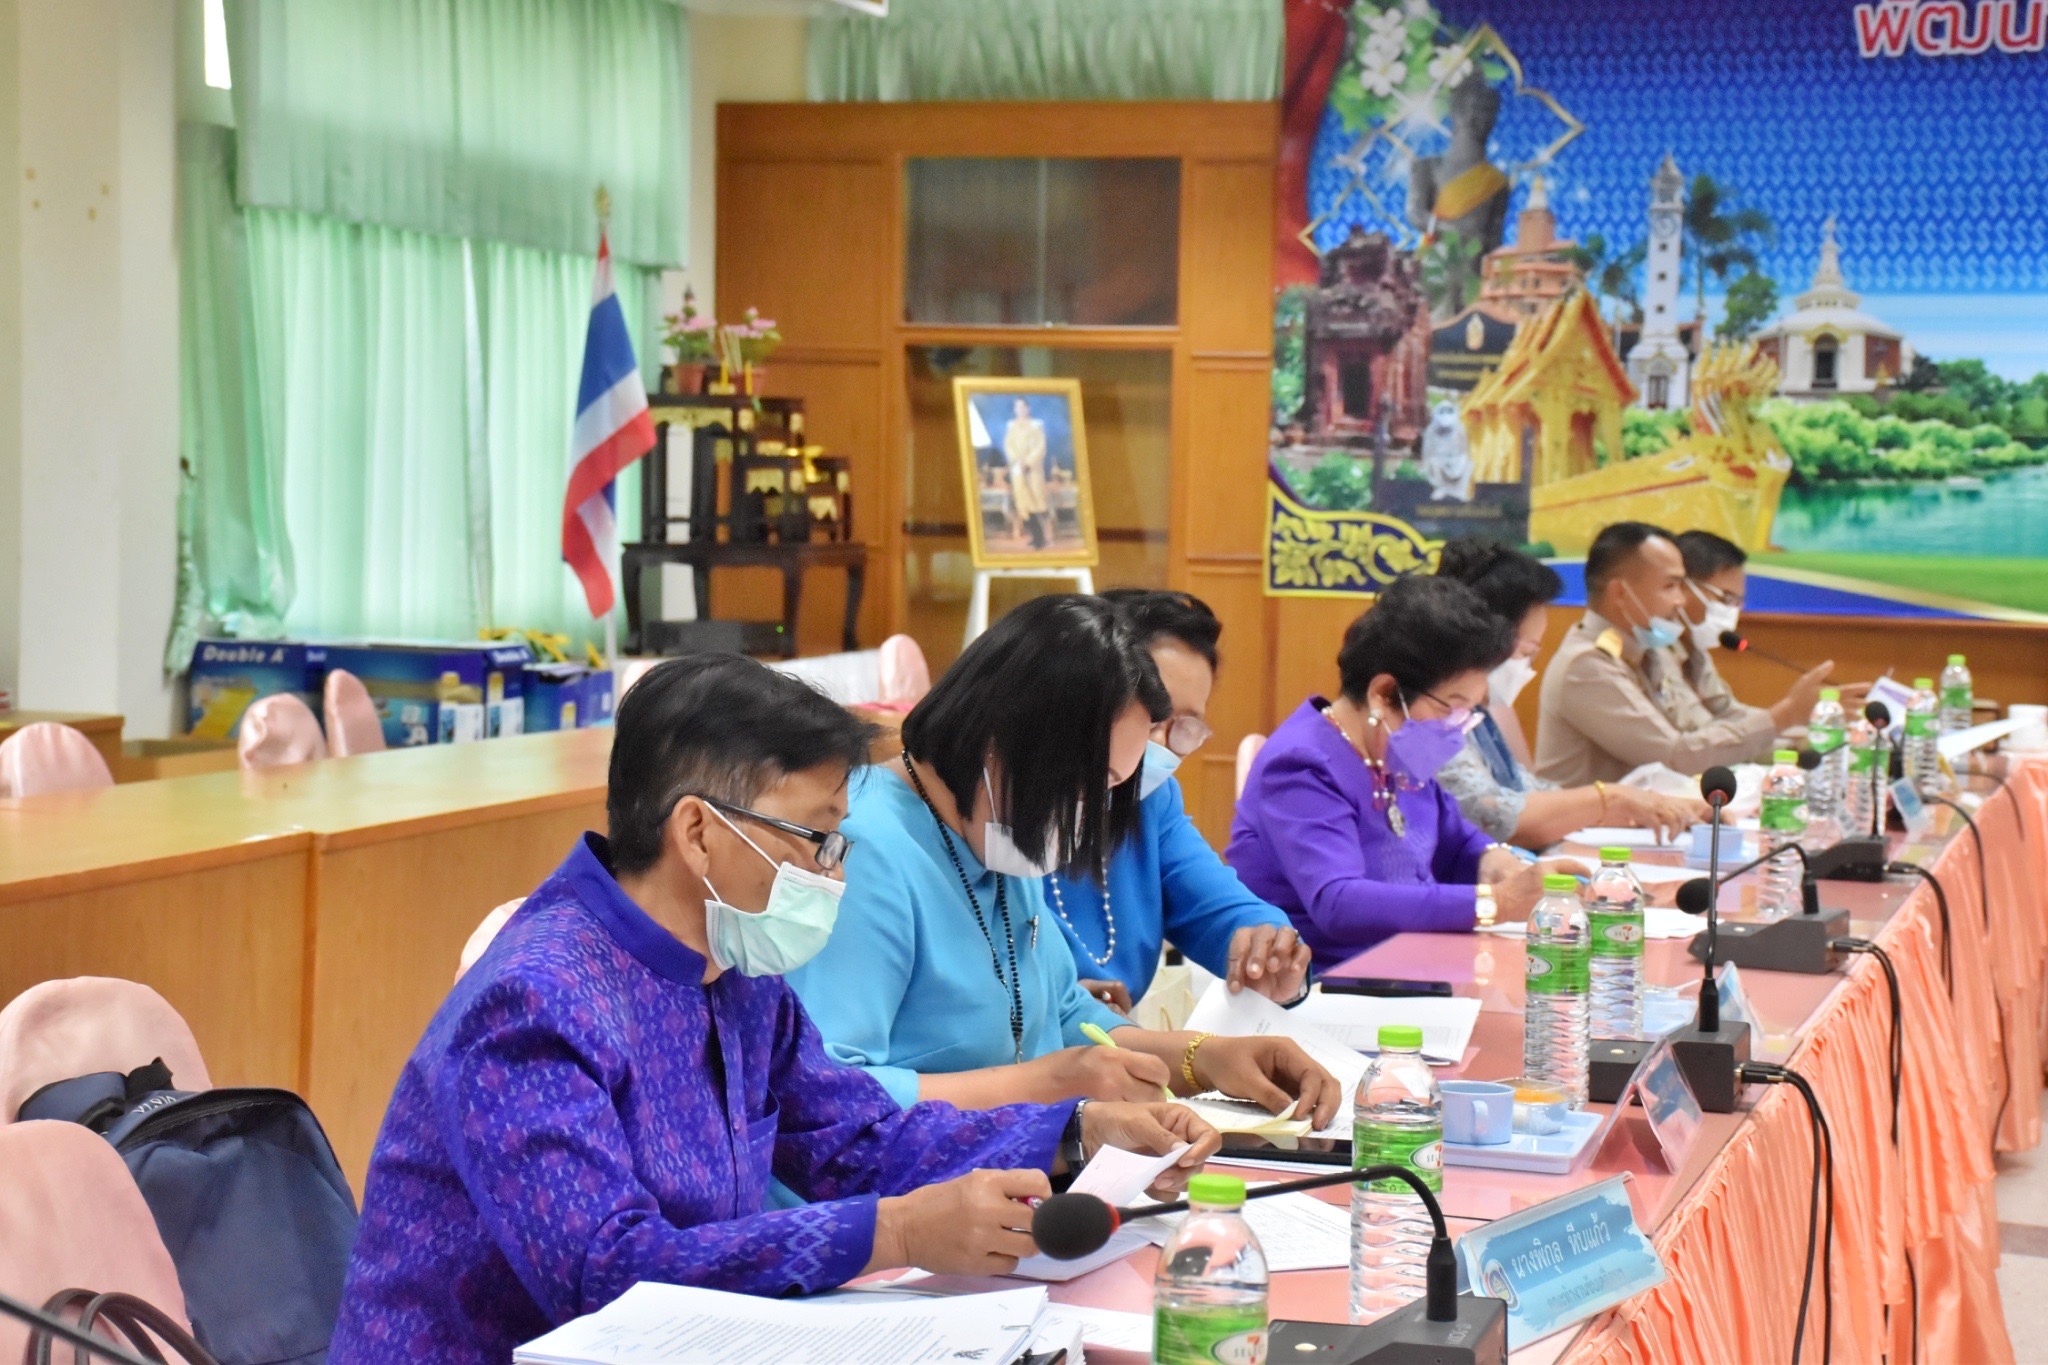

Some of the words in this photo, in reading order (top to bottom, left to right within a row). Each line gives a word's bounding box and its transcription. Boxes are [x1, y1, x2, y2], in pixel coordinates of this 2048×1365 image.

[203, 645, 266, 663] Double
[271, 648, 284, 663] A
[1511, 1237, 1564, 1278] นางพิกุล
[1566, 1212, 1611, 1255] หีบแก้ว
